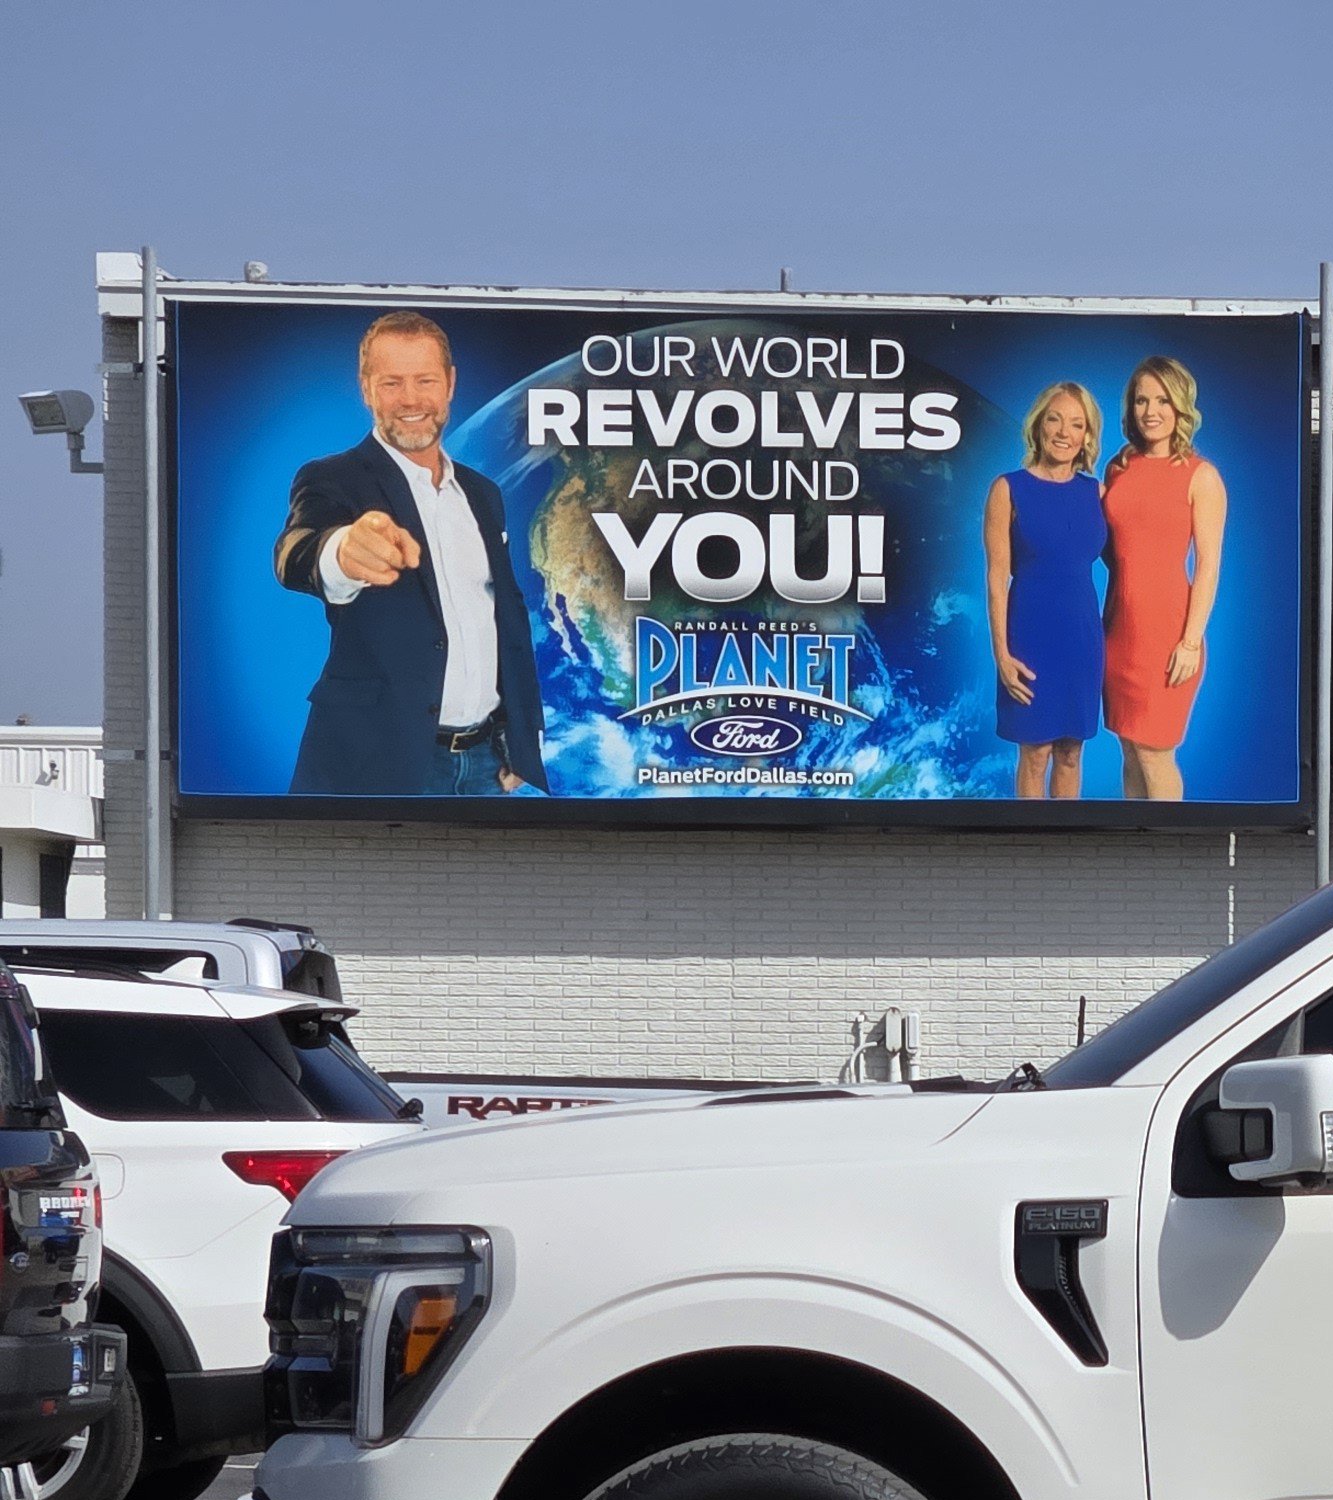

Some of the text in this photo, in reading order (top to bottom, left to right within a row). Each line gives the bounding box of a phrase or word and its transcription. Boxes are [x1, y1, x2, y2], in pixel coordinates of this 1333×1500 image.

[582, 335, 905, 379] OUR WORLD
[528, 388, 961, 450] REVOLVES
[628, 458, 859, 501] AROUND
[591, 511, 886, 604] YOU!
[675, 621, 818, 632] RANDALL REED'S
[635, 616, 856, 709] PLANET
[641, 697, 844, 726] DALLAS LOVE FIELD
[712, 720, 780, 749] Ford
[638, 767, 854, 786] PlanetFordDallas.com
[1026, 1207, 1100, 1220] F-150
[1028, 1221, 1096, 1231] PLATINUM
